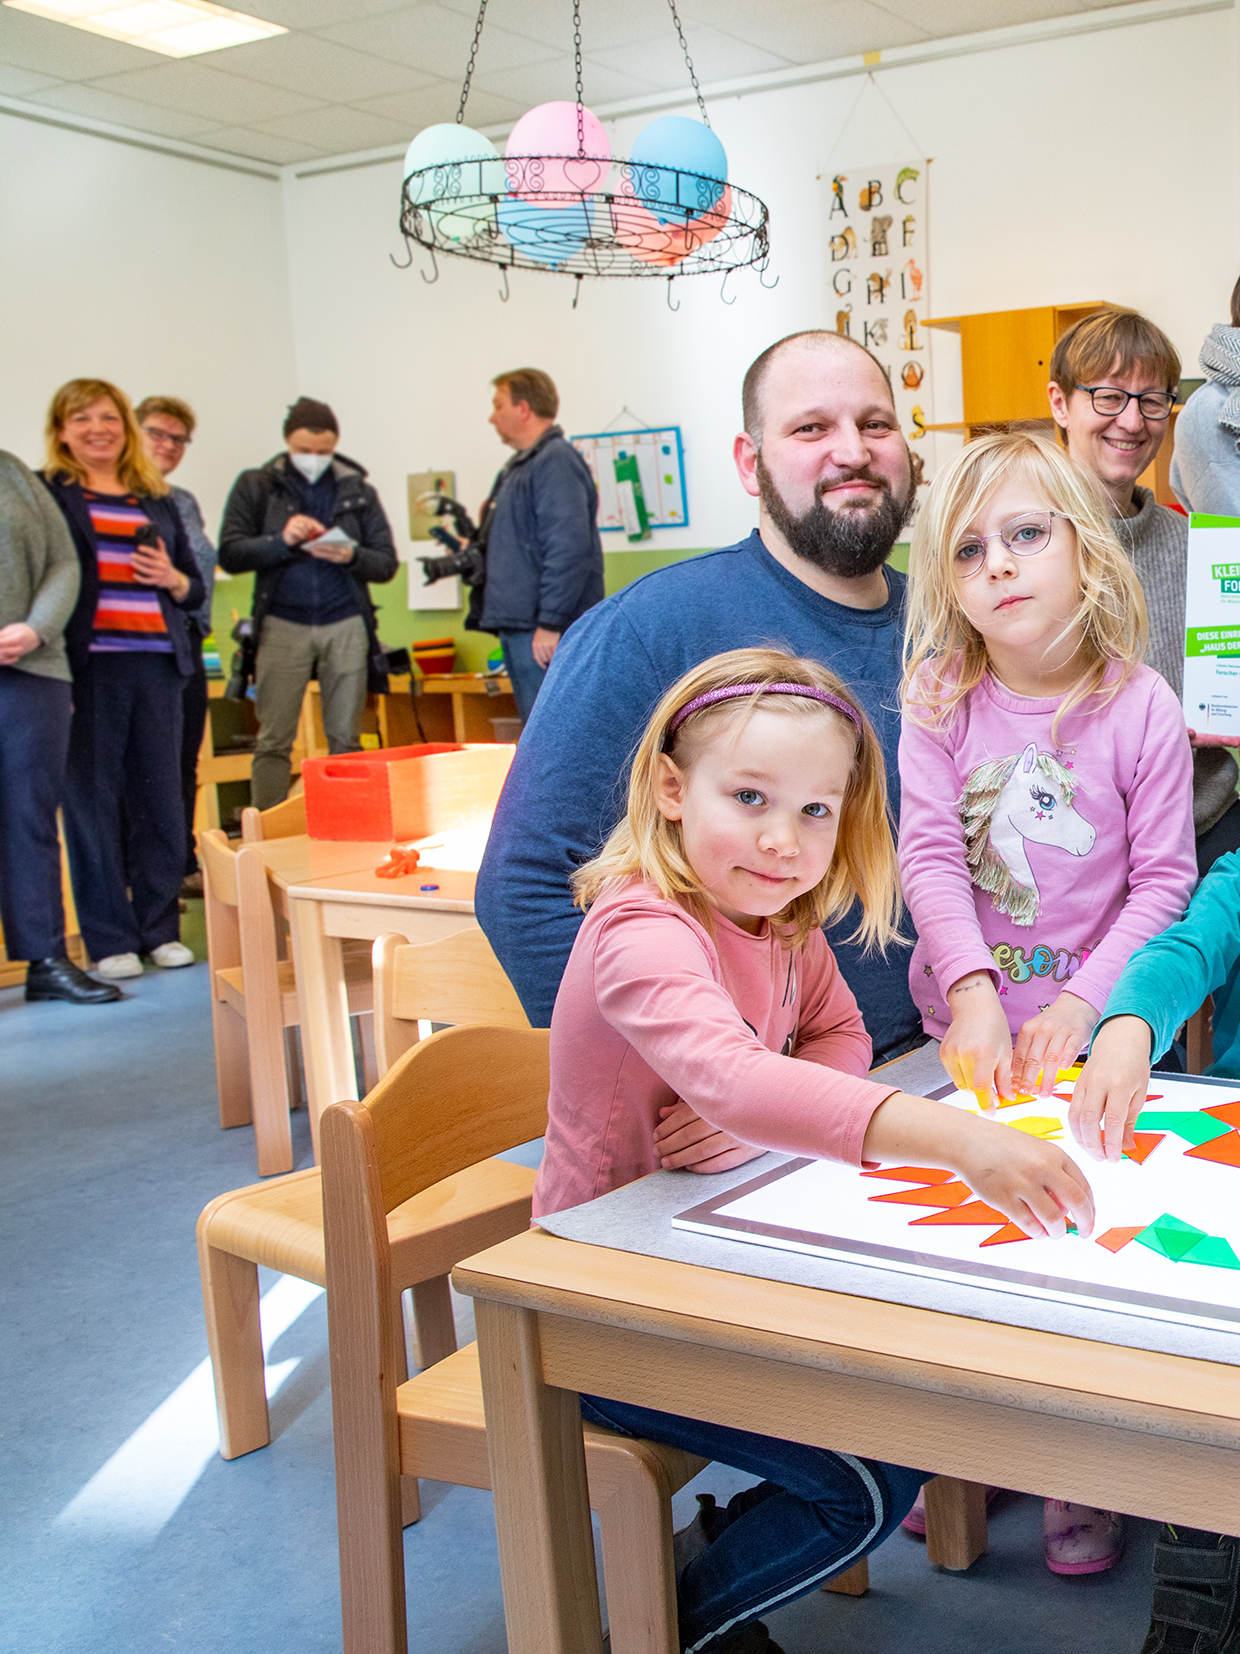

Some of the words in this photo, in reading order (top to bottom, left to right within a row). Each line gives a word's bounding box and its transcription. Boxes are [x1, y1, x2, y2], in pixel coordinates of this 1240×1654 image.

[829, 187, 848, 219] A
[868, 180, 883, 207] B
[897, 176, 917, 205] C
[830, 235, 849, 261] D
[903, 218, 915, 247] F
[833, 268, 851, 296] G
[867, 276, 884, 304] H
[901, 272, 906, 299] I
[864, 320, 881, 347] K
[909, 325, 924, 350] L
[1196, 632, 1219, 641] DIESE
